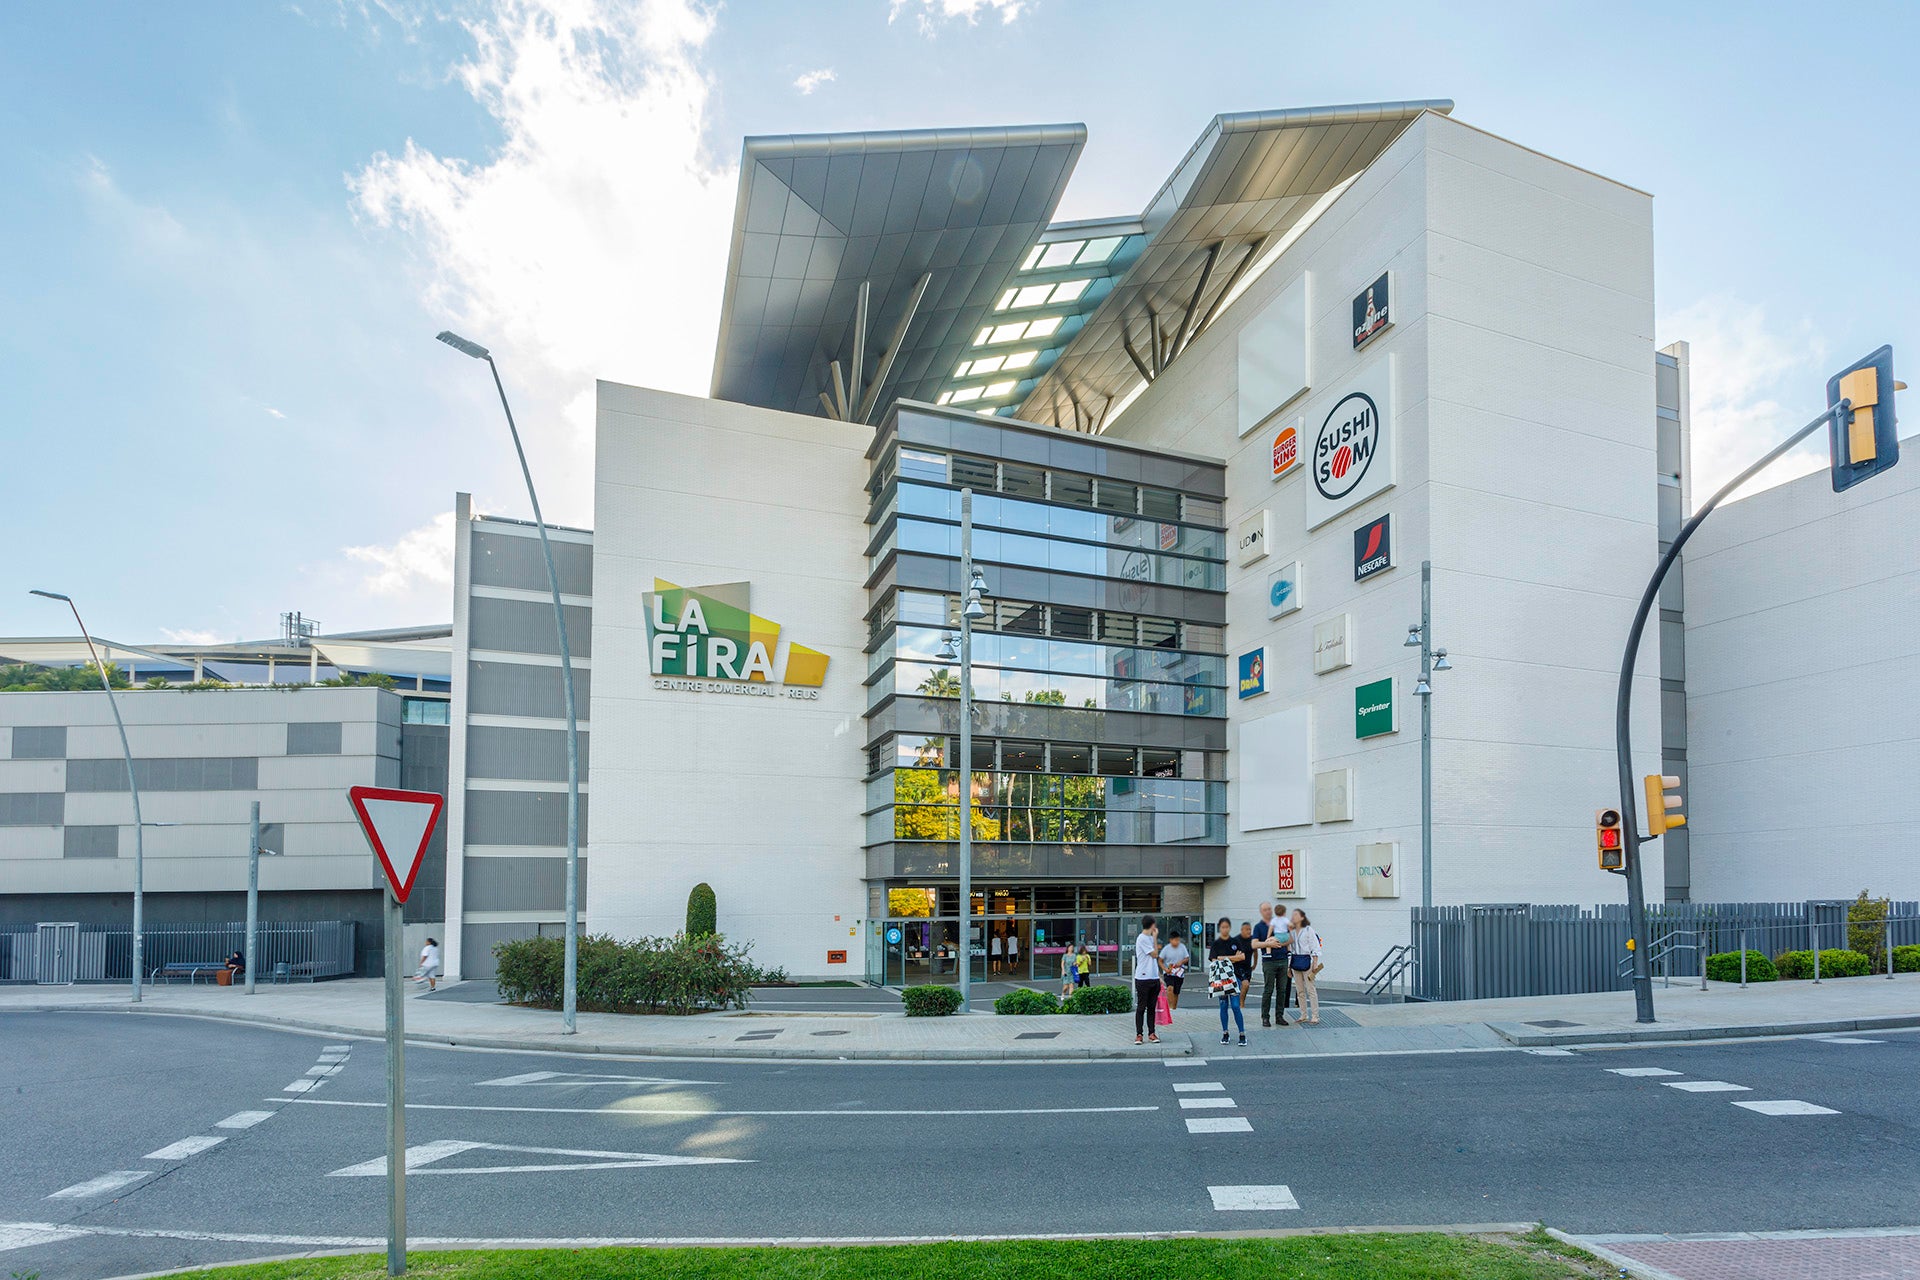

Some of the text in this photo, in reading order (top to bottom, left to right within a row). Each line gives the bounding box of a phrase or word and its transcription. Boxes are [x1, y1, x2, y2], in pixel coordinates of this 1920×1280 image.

[1319, 408, 1370, 458] SUSHI
[1273, 436, 1297, 458] BURGER
[1273, 446, 1297, 469] KING
[1319, 436, 1370, 484] SOM
[1239, 528, 1264, 550] UDON
[653, 594, 710, 636] LA
[653, 679, 703, 693] CENTRE
[706, 683, 776, 698] COMERCIAL
[788, 688, 819, 701] REUS
[1357, 702, 1391, 717] Sprinter
[1280, 856, 1291, 868] KI
[1280, 867, 1293, 878] WO
[1280, 878, 1293, 889] KO
